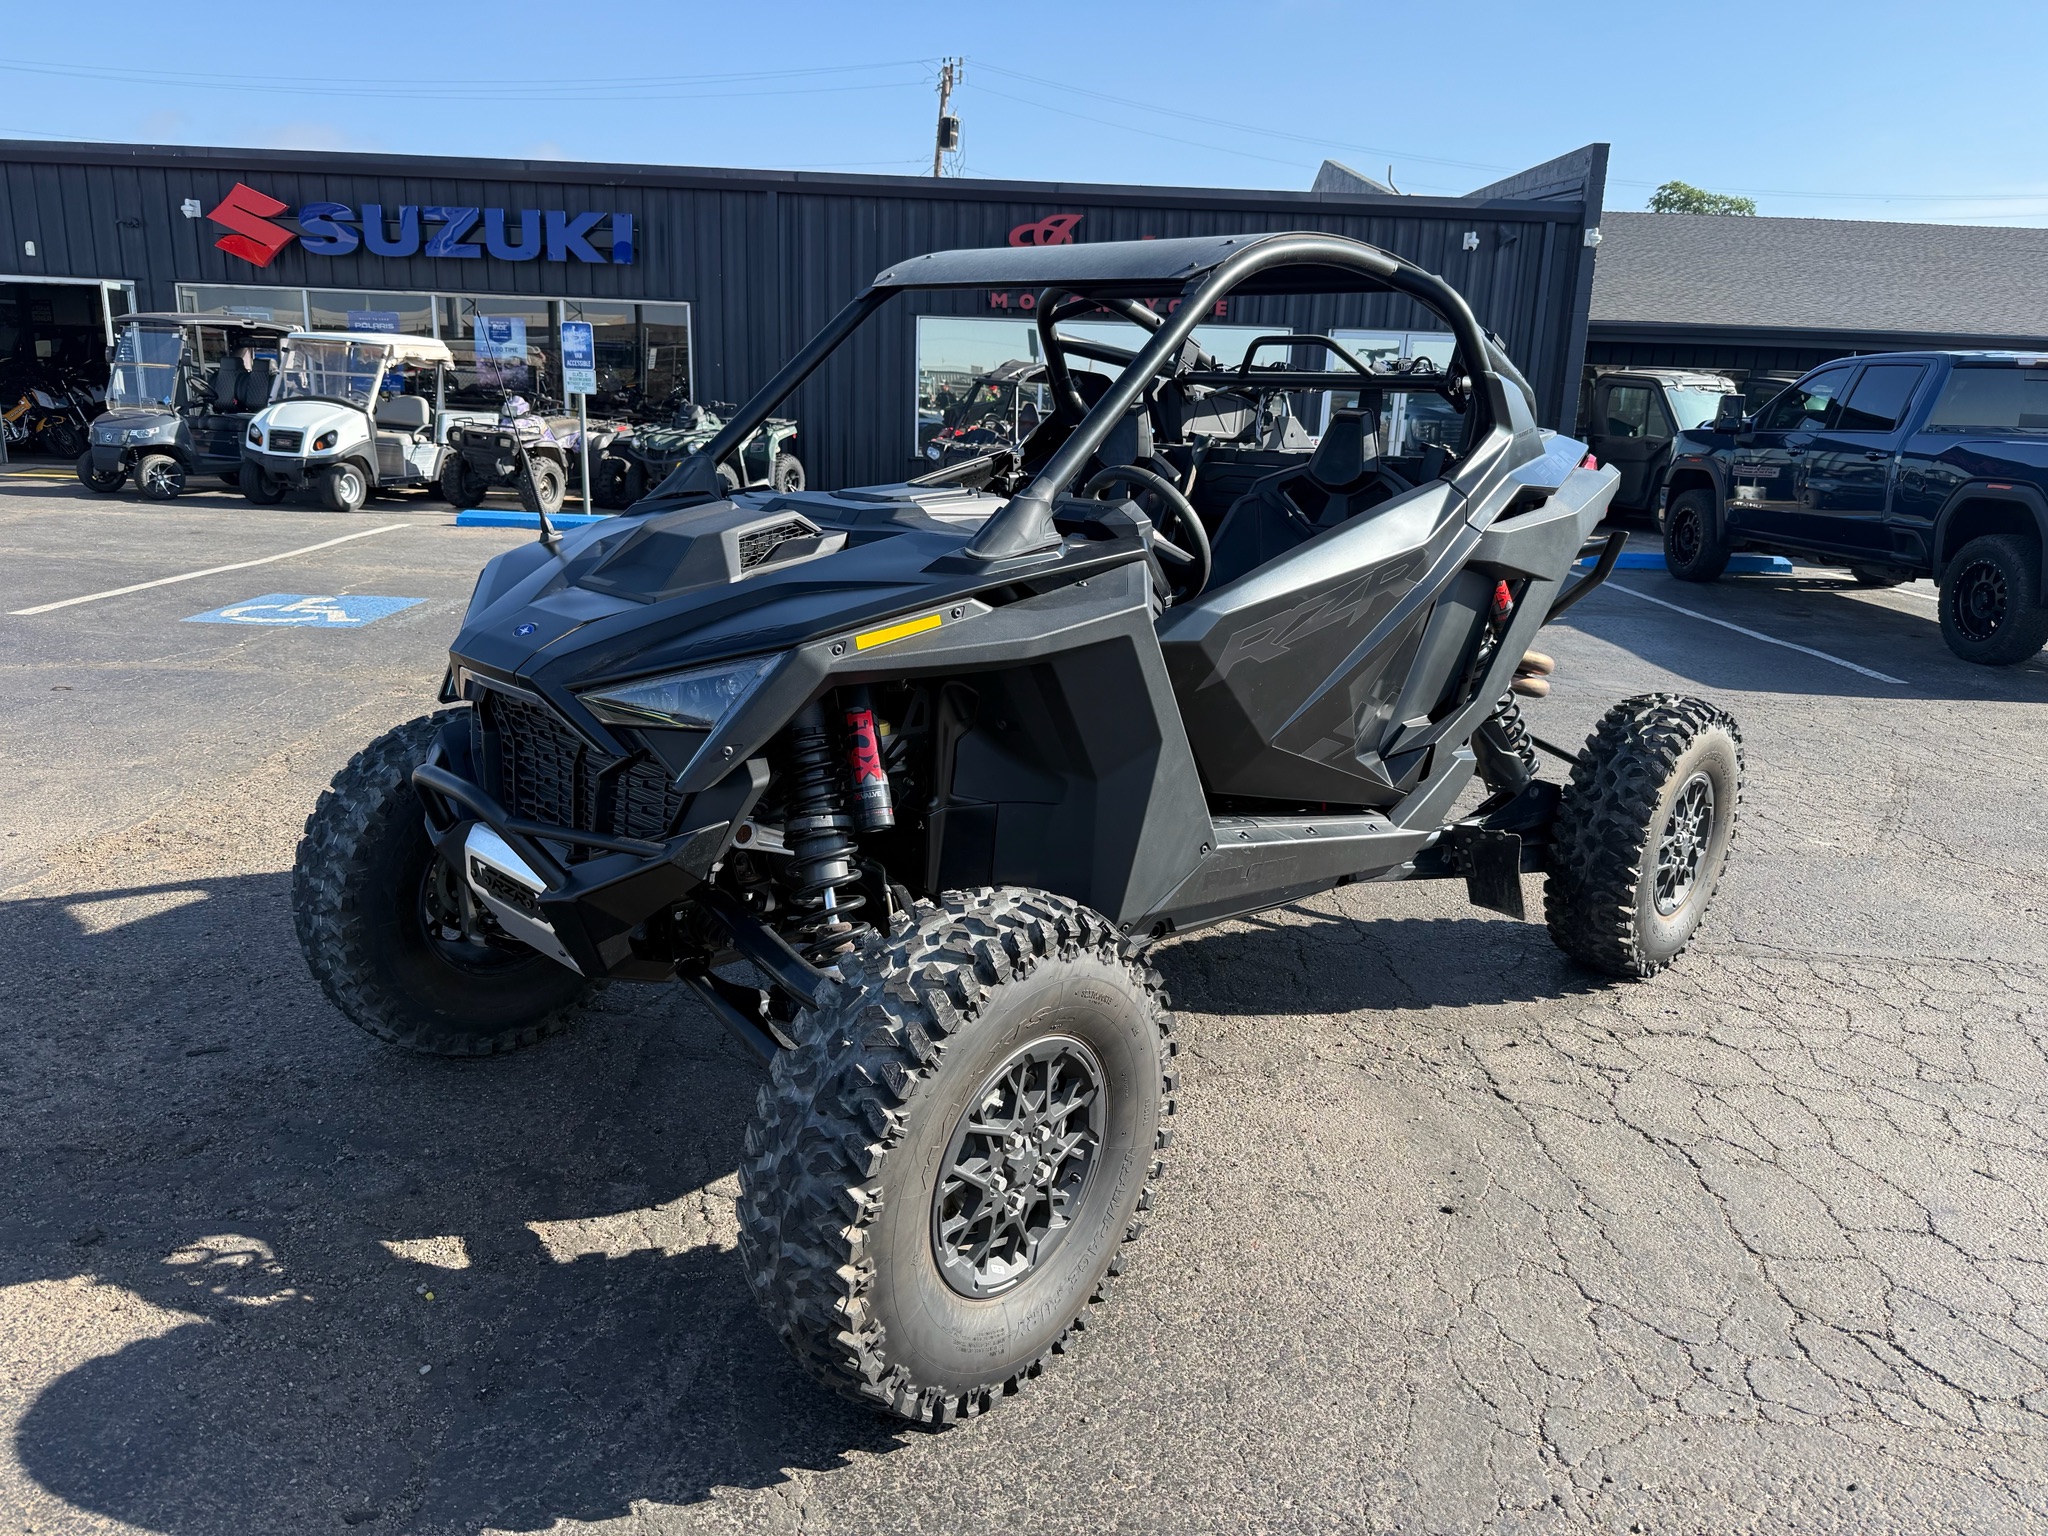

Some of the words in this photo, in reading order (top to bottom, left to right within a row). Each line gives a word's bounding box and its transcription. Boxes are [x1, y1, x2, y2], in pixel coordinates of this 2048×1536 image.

[297, 201, 634, 266] SUZUKI
[354, 322, 395, 330] POLARIS
[1194, 547, 1429, 692] RZR
[846, 709, 885, 784] FOX
[492, 878, 528, 907] RZR
